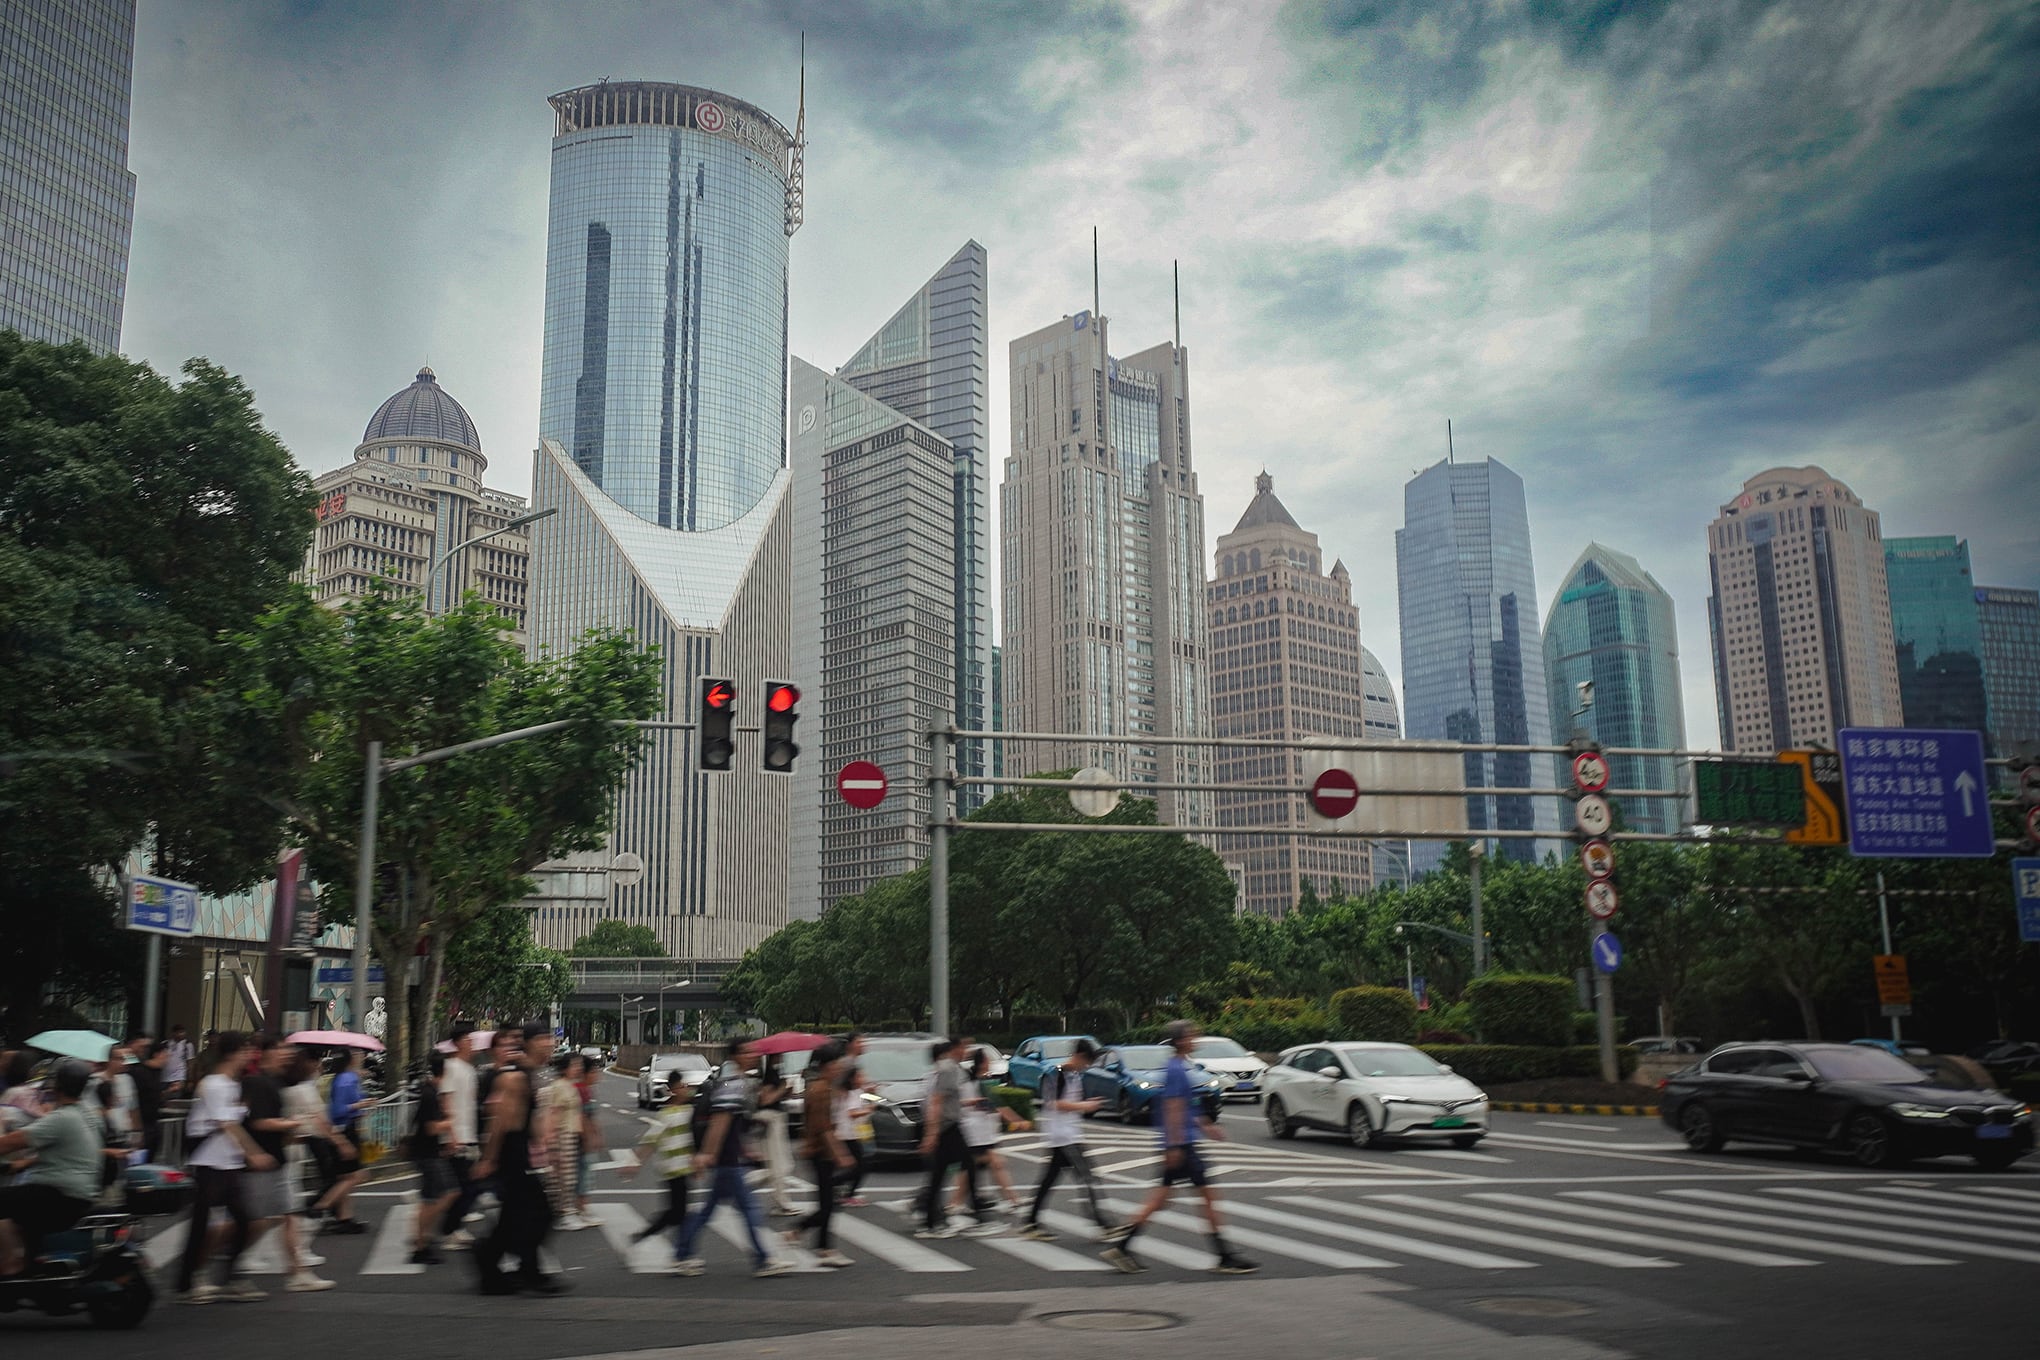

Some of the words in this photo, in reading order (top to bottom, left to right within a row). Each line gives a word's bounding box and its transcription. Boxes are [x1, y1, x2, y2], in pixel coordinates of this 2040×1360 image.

[1847, 738, 1940, 759] 陆家嘴环路
[1851, 774, 1945, 796] 浦东大道地道
